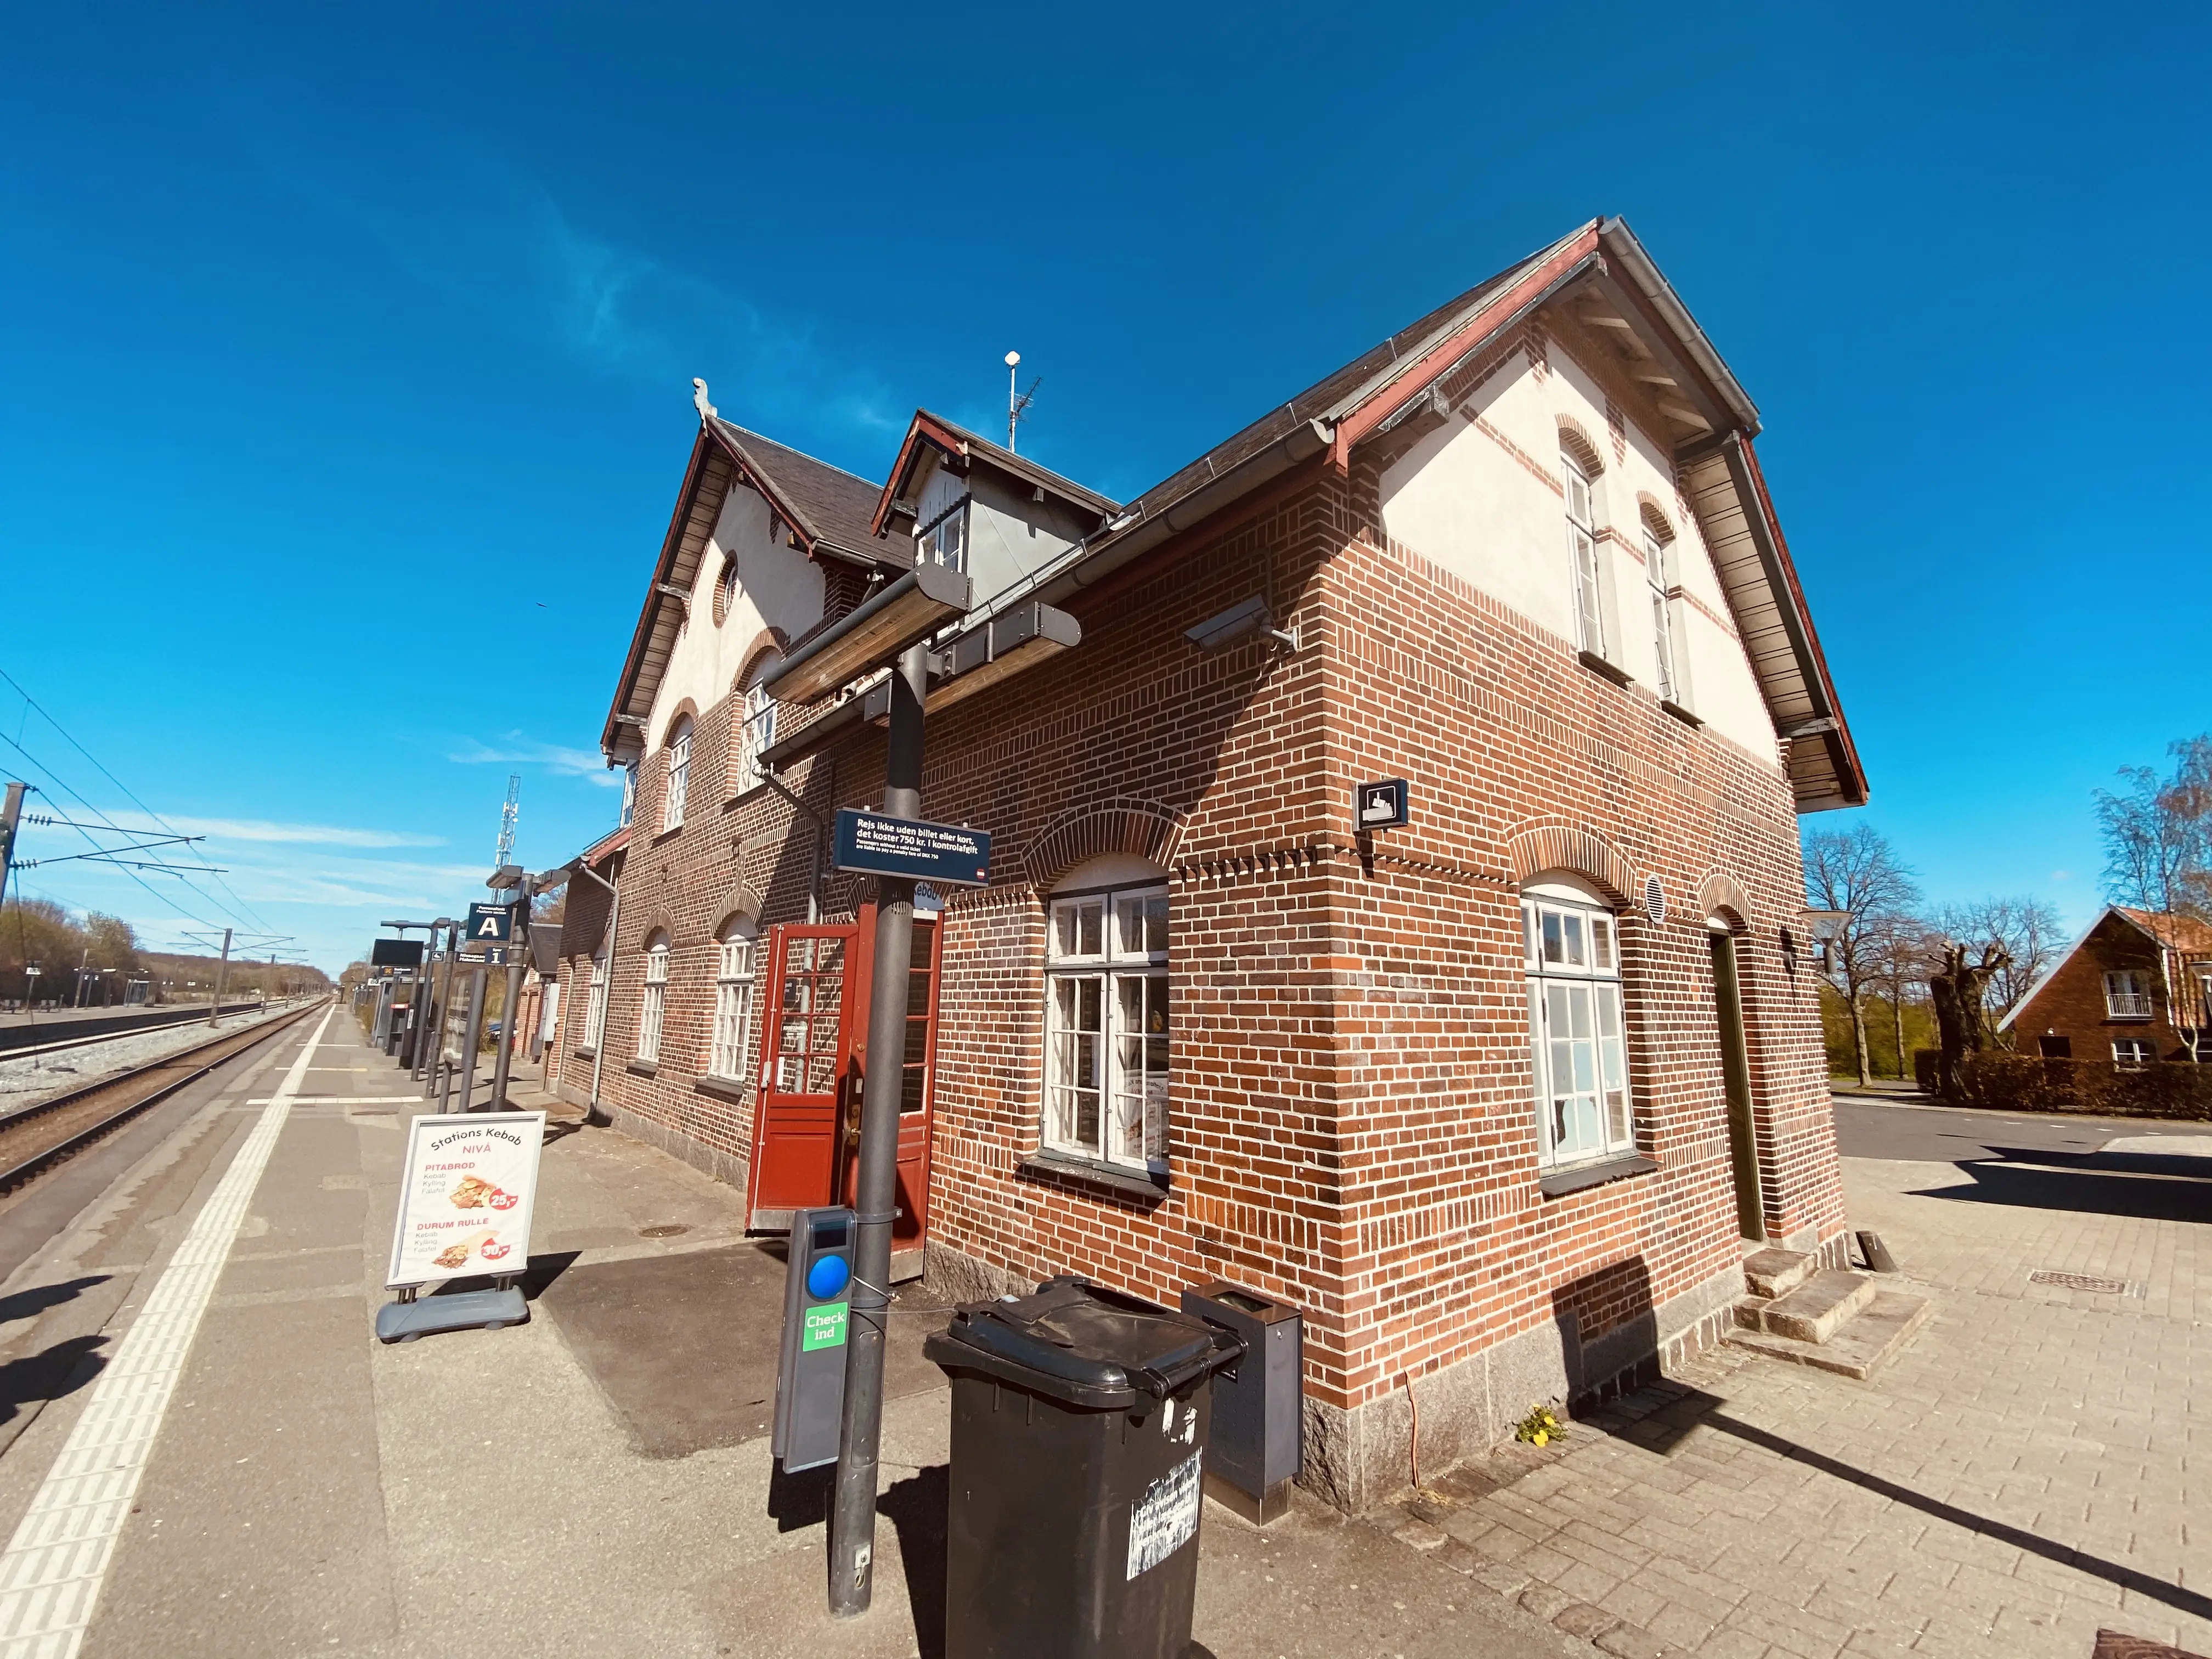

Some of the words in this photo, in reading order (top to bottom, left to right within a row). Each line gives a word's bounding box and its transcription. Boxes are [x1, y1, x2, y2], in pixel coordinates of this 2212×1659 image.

[857, 819, 875, 830] Rejs
[877, 822, 894, 832] ikke
[896, 826, 916, 835] uden
[918, 828, 938, 839] billet
[939, 832, 956, 842] eller
[957, 834, 974, 845] kort,
[857, 828, 871, 838] det
[873, 831, 899, 842] koster
[900, 835, 915, 844] 750
[916, 837, 926, 847] kr.
[933, 840, 978, 854] kontrolafgift
[915, 881, 938, 901] ebab
[478, 917, 499, 936] A
[491, 952, 500, 963] 1
[431, 1130, 482, 1151] Stations
[486, 1128, 521, 1146] Kebab
[462, 1141, 491, 1154] NIVÅ
[457, 1218, 489, 1227] RULLE
[806, 1312, 845, 1328] Check
[814, 1327, 835, 1340] ind
